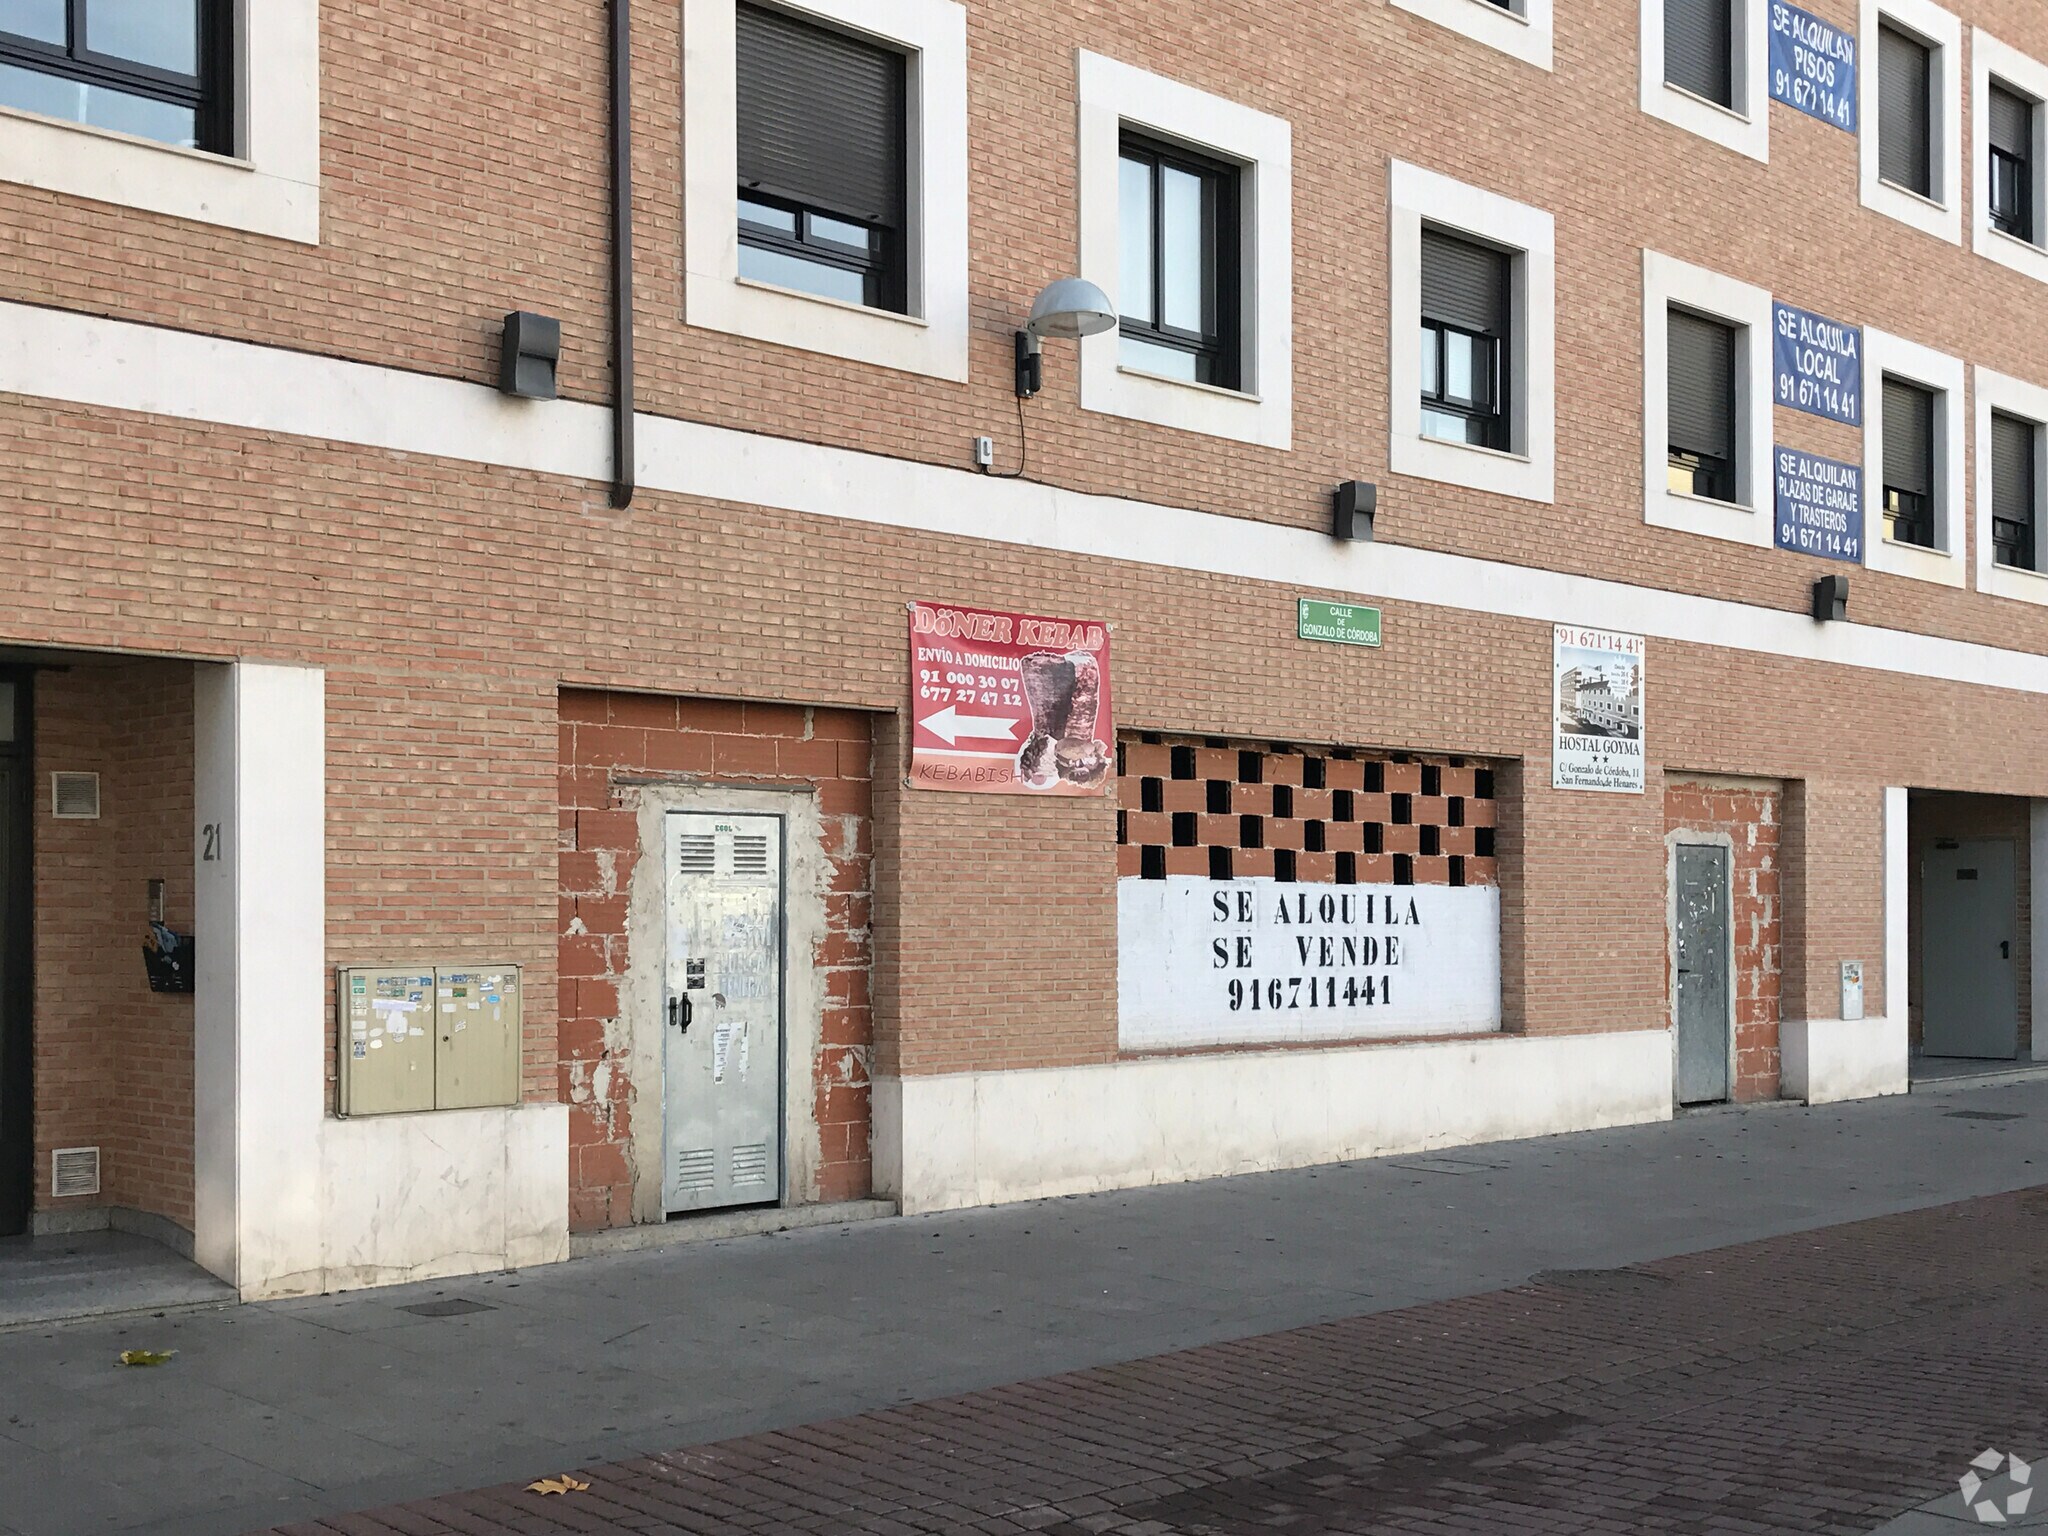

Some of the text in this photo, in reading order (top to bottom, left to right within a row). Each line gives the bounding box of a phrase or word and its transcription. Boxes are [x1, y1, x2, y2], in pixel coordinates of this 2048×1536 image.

[1773, 4, 1853, 66] SE ALQUILAN
[1794, 45, 1835, 87] PISOS
[1776, 69, 1850, 126] 91 671 14 41
[1777, 309, 1857, 359] SE ALQUILA
[1796, 346, 1841, 385] LOCAL
[1780, 373, 1854, 419] 91 671 14 41
[1780, 453, 1856, 490] SE ALQUILAN
[1779, 476, 1858, 513] PLAZAS DE GARAJE
[1790, 502, 1847, 533] Y TRASTEROS
[1782, 523, 1858, 557] 91 671 14 41
[913, 606, 1105, 650] DÖNER KEBAB
[1330, 606, 1353, 618] CALLE
[1337, 618, 1346, 626] DE
[1302, 623, 1378, 642] GONZALO DE CÓRDOBA
[1560, 628, 1639, 654] 91 671 14 41
[918, 647, 1020, 672] ENVÍO A DOMICILIO
[920, 669, 1020, 691] 91 000 30 07
[920, 685, 1022, 707] 677 27 47 12
[1559, 736, 1640, 755] HOSTAL GOYMA
[918, 763, 1025, 784] KEBABISH
[1559, 762, 1568, 773] C/
[1568, 763, 1594, 775] Gonzalo
[1594, 765, 1603, 775] de
[1561, 774, 1638, 789] San Fernando de Henares
[203, 823, 221, 861] 21
[1213, 890, 1420, 925] SE ALQUILA
[1213, 936, 1399, 969] SE VENDE
[1228, 975, 1391, 1011] 916711441
